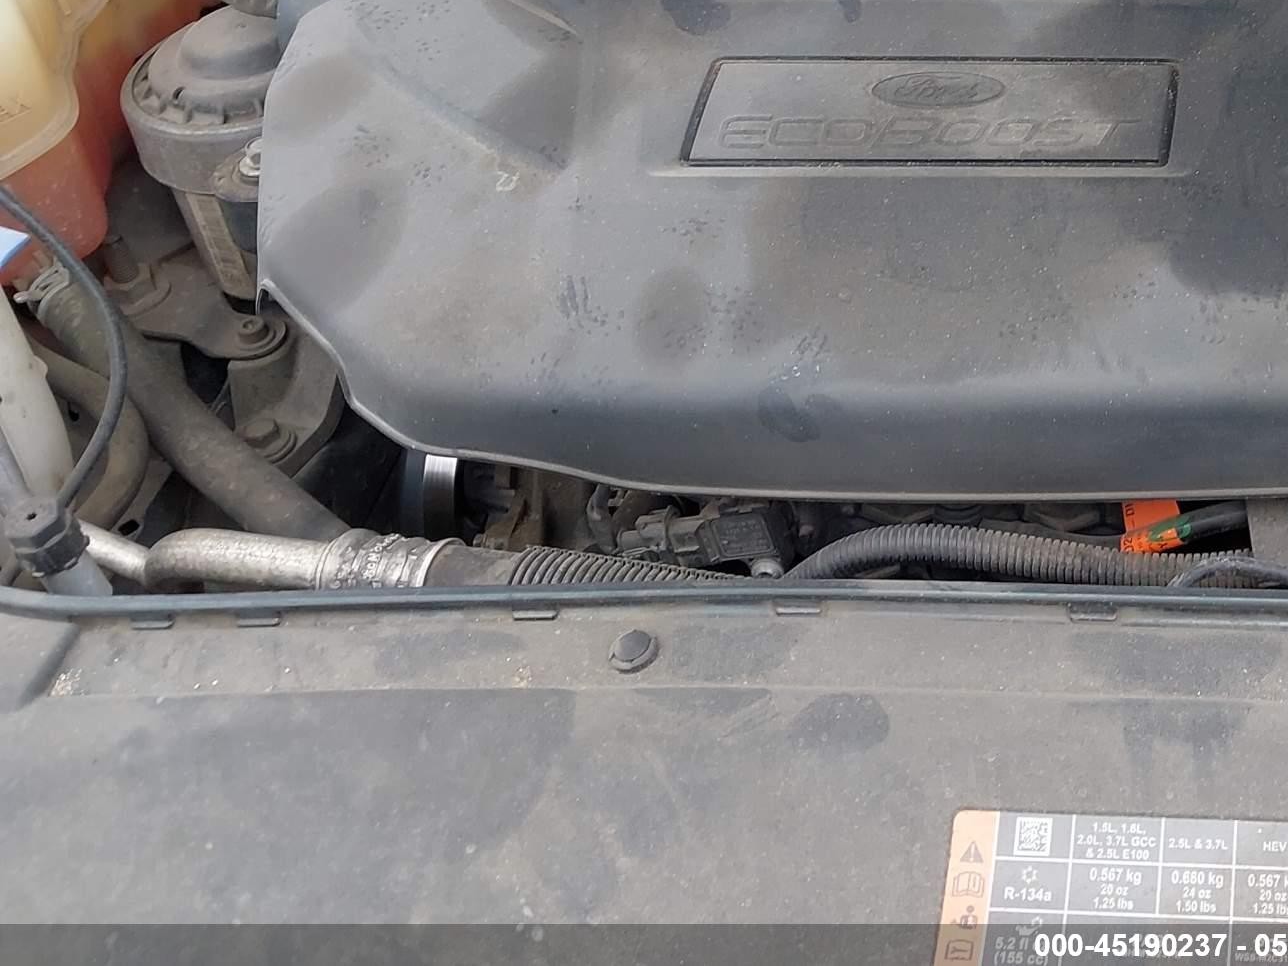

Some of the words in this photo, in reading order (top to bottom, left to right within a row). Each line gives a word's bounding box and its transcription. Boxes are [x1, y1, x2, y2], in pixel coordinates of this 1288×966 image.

[1076, 834, 1103, 846] 2.0L,
[1105, 835, 1128, 847] 3.7L
[1131, 836, 1156, 848] GCC
[1205, 839, 1228, 850] 3.7L
[1263, 841, 1287, 852] HEV
[1097, 848, 1119, 859] 2.5L
[1122, 849, 1149, 860] E100
[1089, 867, 1122, 881] 0.567
[1126, 869, 1142, 885] kg
[1208, 872, 1224, 888] kg
[1003, 887, 1052, 902] R-134a
[1100, 885, 1113, 895] 20
[1115, 887, 1128, 896] oz
[1198, 889, 1211, 899] oz
[1274, 892, 1287, 902] oz
[1092, 897, 1115, 909] 1.25
[1117, 898, 1133, 910] lbs
[1200, 901, 1216, 913] lbs
